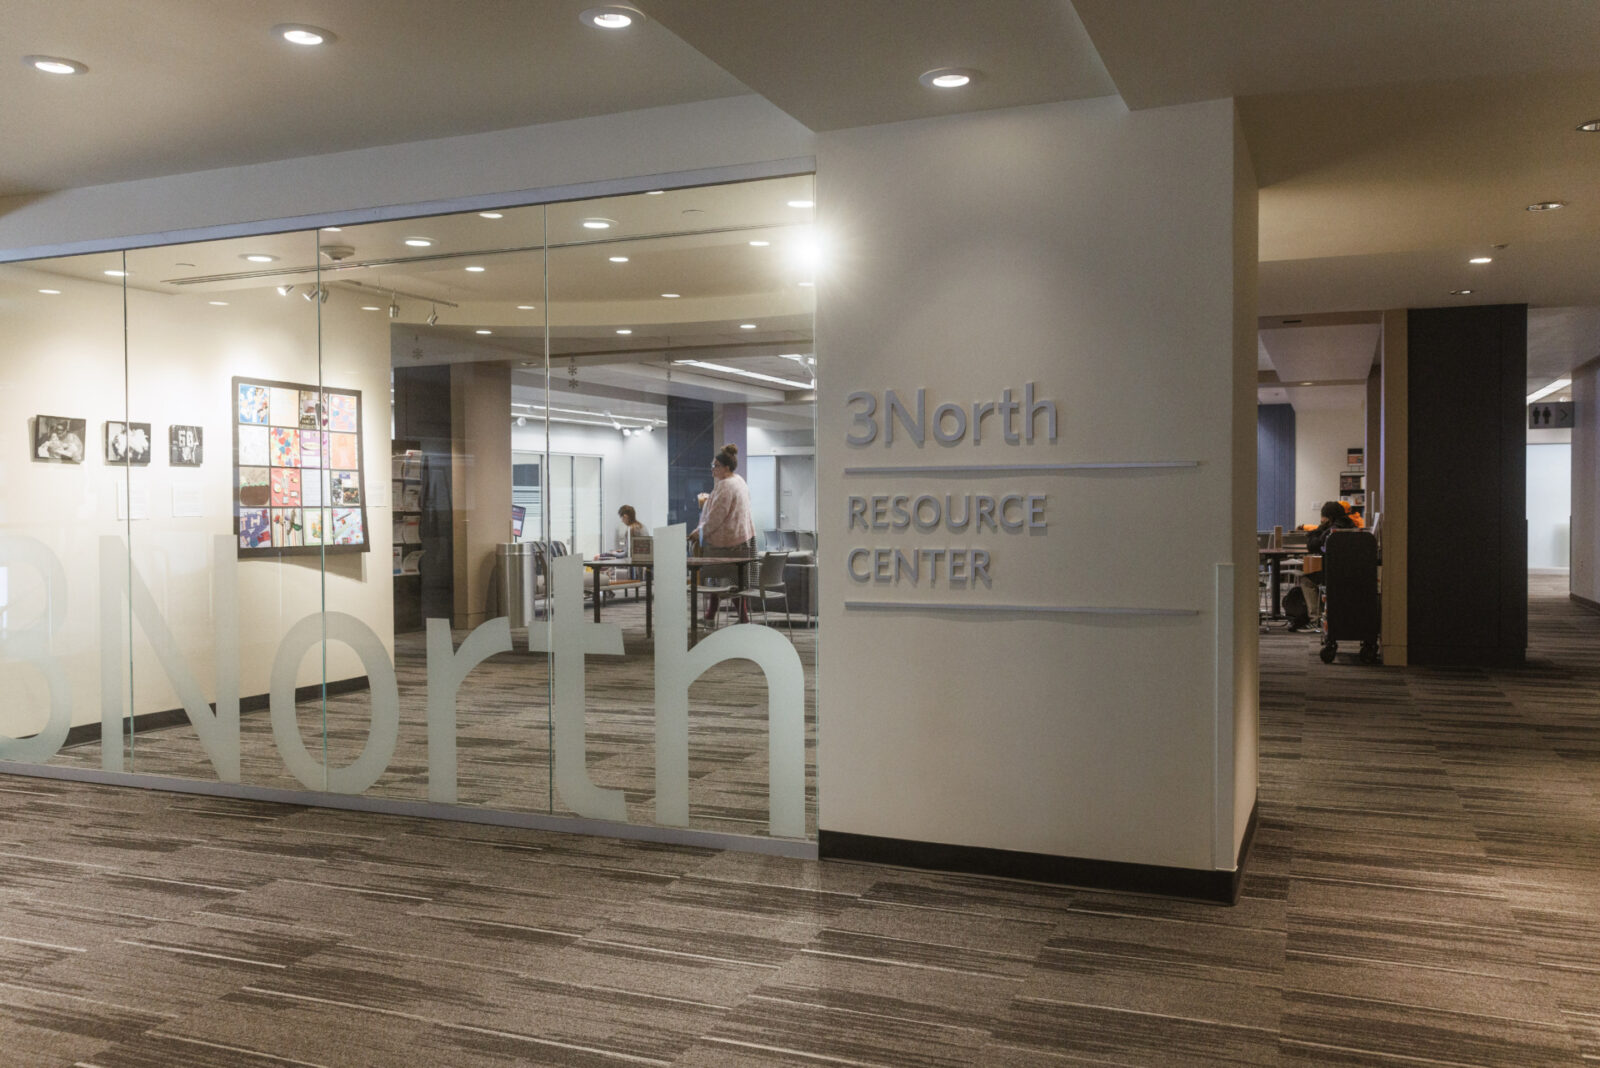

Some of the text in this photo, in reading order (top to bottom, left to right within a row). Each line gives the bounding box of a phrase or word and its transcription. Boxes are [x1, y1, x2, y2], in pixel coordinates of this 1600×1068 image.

[846, 382, 1058, 445] 3North
[848, 494, 1048, 529] RESOURCE
[847, 547, 992, 583] CENTER
